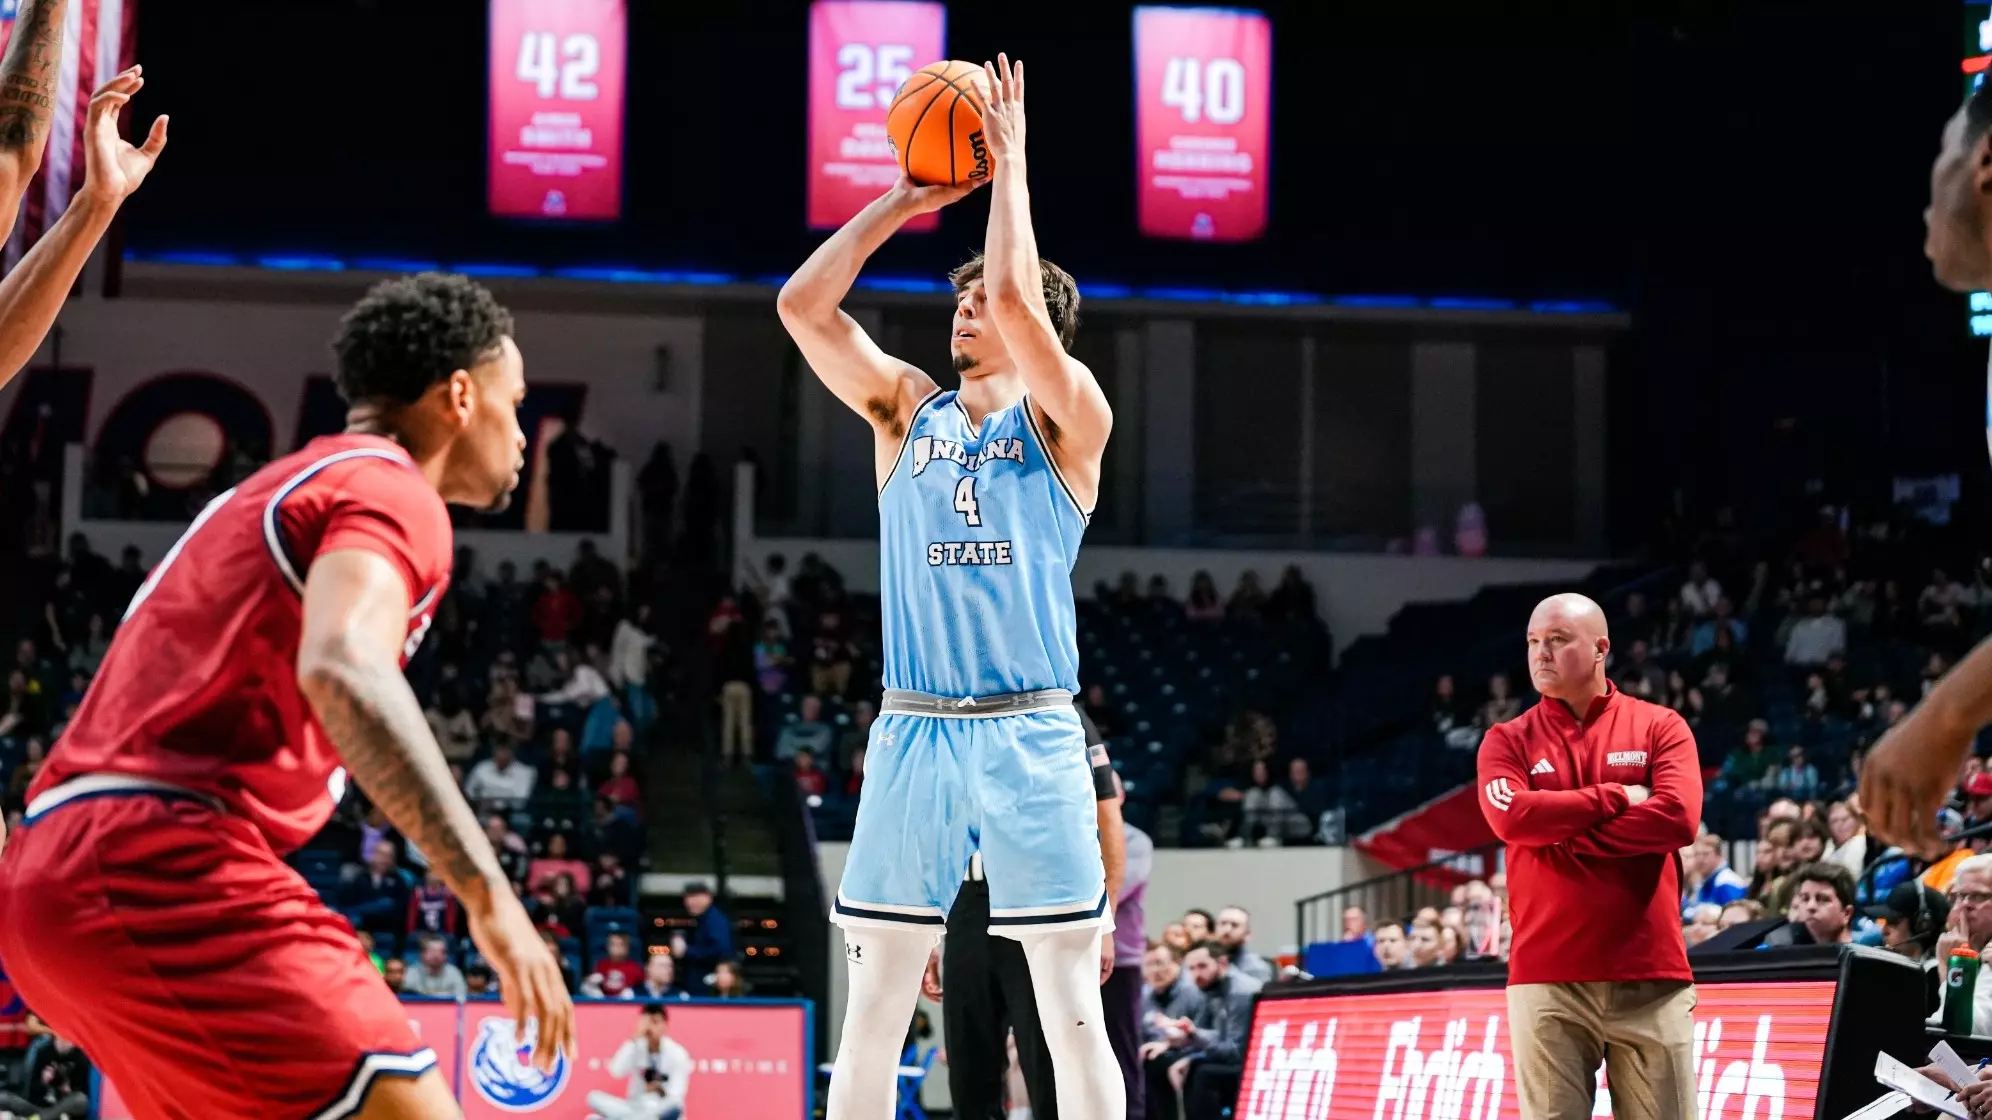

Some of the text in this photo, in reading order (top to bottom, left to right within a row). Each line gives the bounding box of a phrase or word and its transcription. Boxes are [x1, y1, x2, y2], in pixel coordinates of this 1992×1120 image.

[515, 31, 599, 99] 42
[836, 43, 914, 110] 25
[1160, 56, 1246, 124] 40
[967, 128, 989, 181] lson
[912, 435, 1025, 479] INDIANA
[953, 475, 983, 527] 4
[927, 540, 1012, 566] STATE
[1606, 750, 1648, 765] BELMONT
